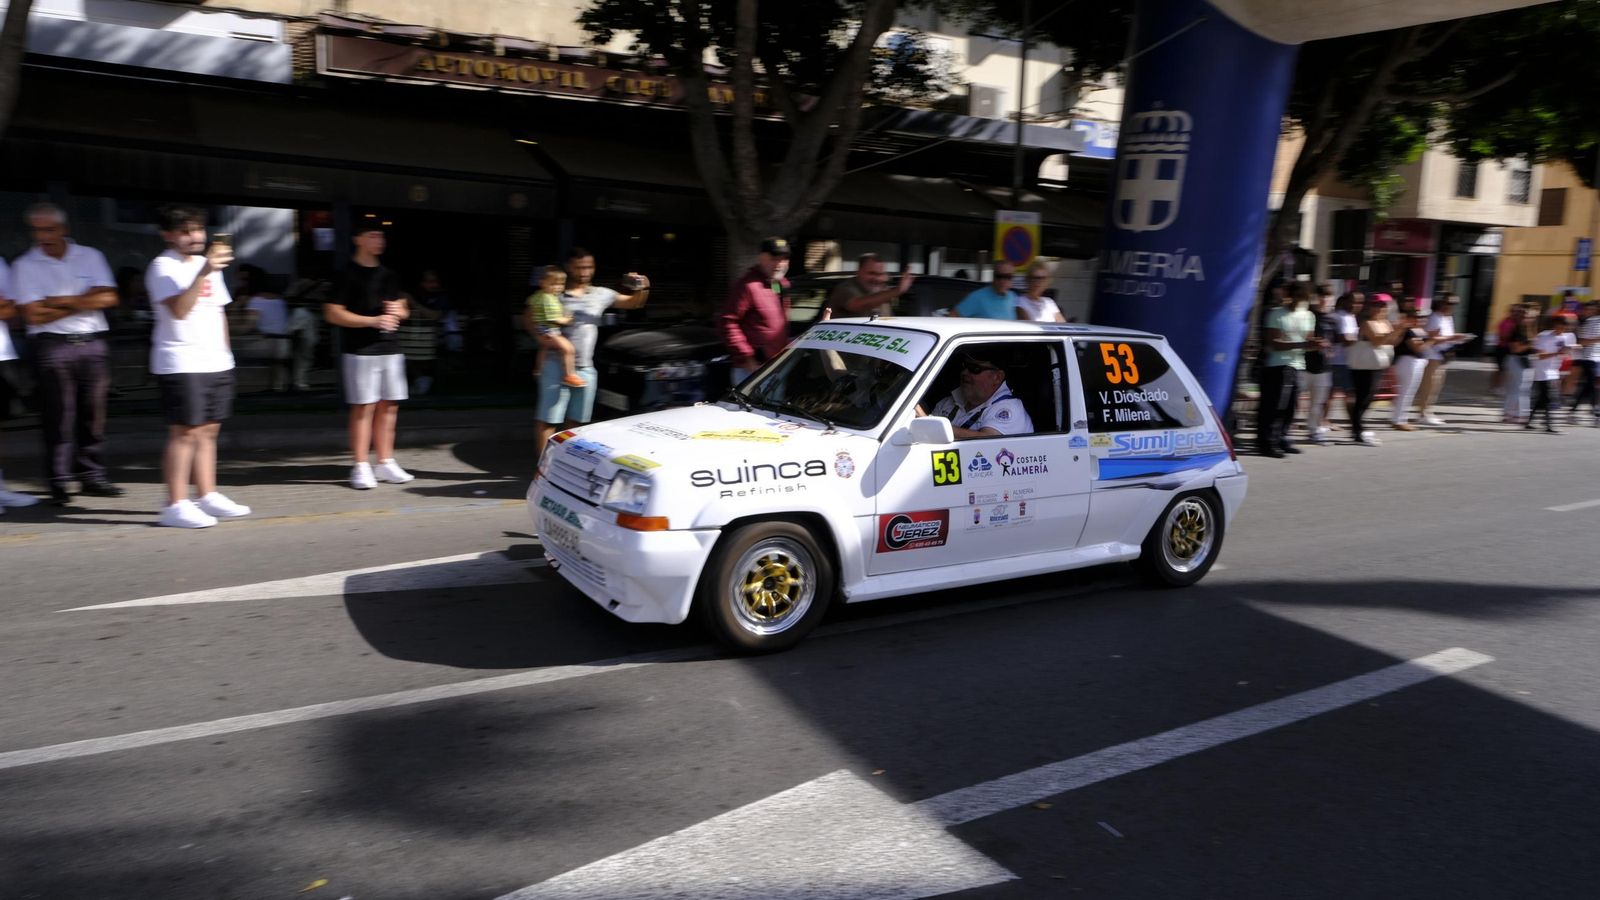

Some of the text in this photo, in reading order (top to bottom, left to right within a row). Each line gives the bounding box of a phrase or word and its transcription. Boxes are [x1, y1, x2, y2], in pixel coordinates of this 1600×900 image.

[886, 338, 911, 354] S.L.
[1099, 342, 1140, 385] 53
[1098, 388, 1169, 405] V. Diosdado
[1102, 408, 1151, 423] F. Milena
[933, 451, 961, 485] 53
[1016, 456, 1038, 464] COSTA
[690, 459, 827, 488] suinca
[1011, 462, 1049, 477] ALMERÍA
[719, 483, 808, 499] Refinish
[895, 526, 939, 540] JEREZ
